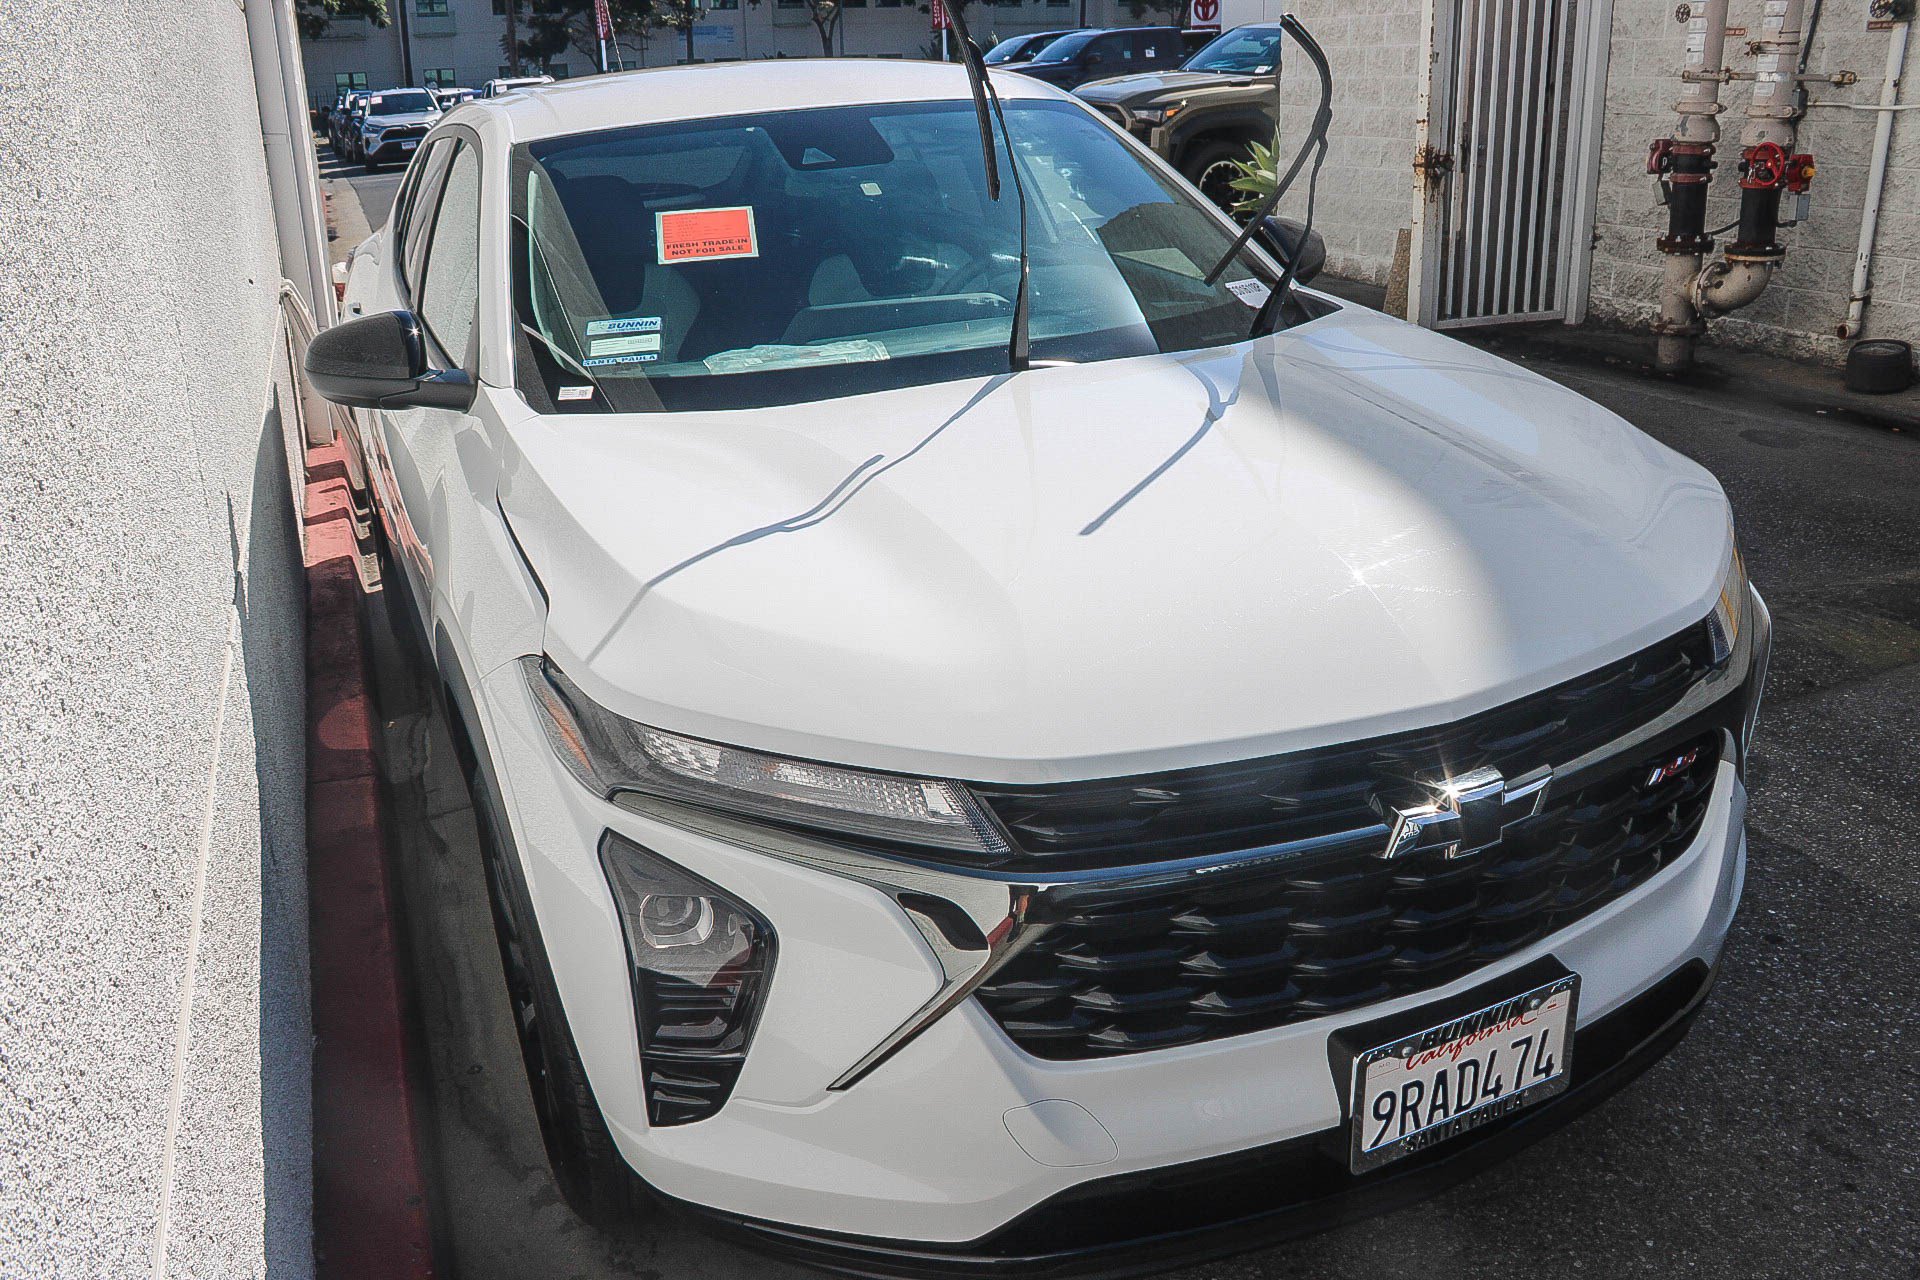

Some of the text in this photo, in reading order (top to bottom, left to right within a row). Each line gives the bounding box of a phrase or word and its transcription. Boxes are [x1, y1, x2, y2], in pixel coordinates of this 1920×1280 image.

[666, 238, 748, 250] FRESH TRADE-IN
[671, 248, 693, 256] NOT
[719, 244, 744, 252] SALE
[607, 320, 658, 329] BUNNIN
[584, 354, 656, 366] SANTA PAULA
[1405, 1012, 1537, 1071] California
[1371, 1028, 1554, 1149] 9RAD474
